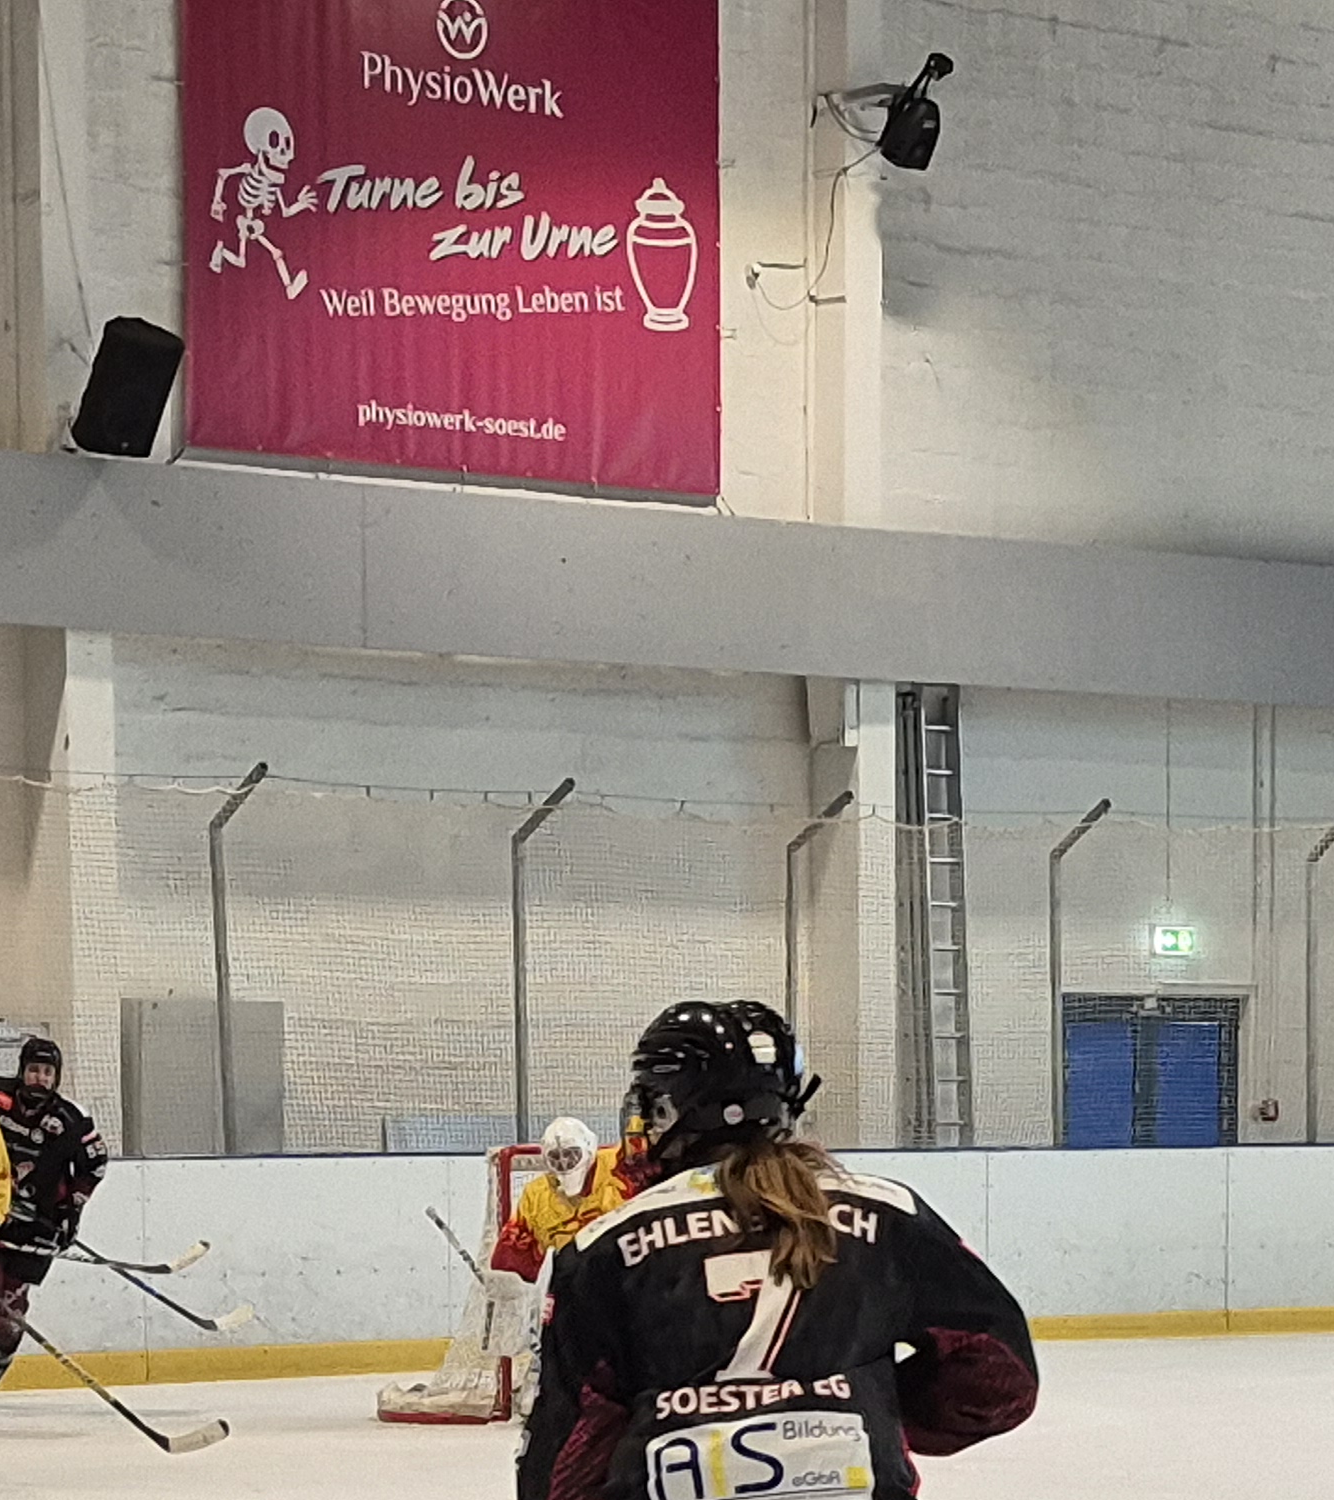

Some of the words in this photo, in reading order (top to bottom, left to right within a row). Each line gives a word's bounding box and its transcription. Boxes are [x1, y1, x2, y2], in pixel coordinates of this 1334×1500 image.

[361, 51, 564, 118] PhysioWerk
[317, 164, 443, 213] Turne
[455, 155, 525, 210] bis
[429, 224, 512, 261] zur
[520, 211, 618, 261] Urne
[320, 288, 374, 317] Weil
[382, 288, 512, 322] Bewegung
[516, 285, 589, 313] Leben
[594, 285, 625, 312] ist
[357, 401, 566, 441] physiowerk-soest.de
[704, 1249, 823, 1380] 7
[655, 1379, 805, 1421] SOESTER
[782, 1419, 862, 1443] Bildung
